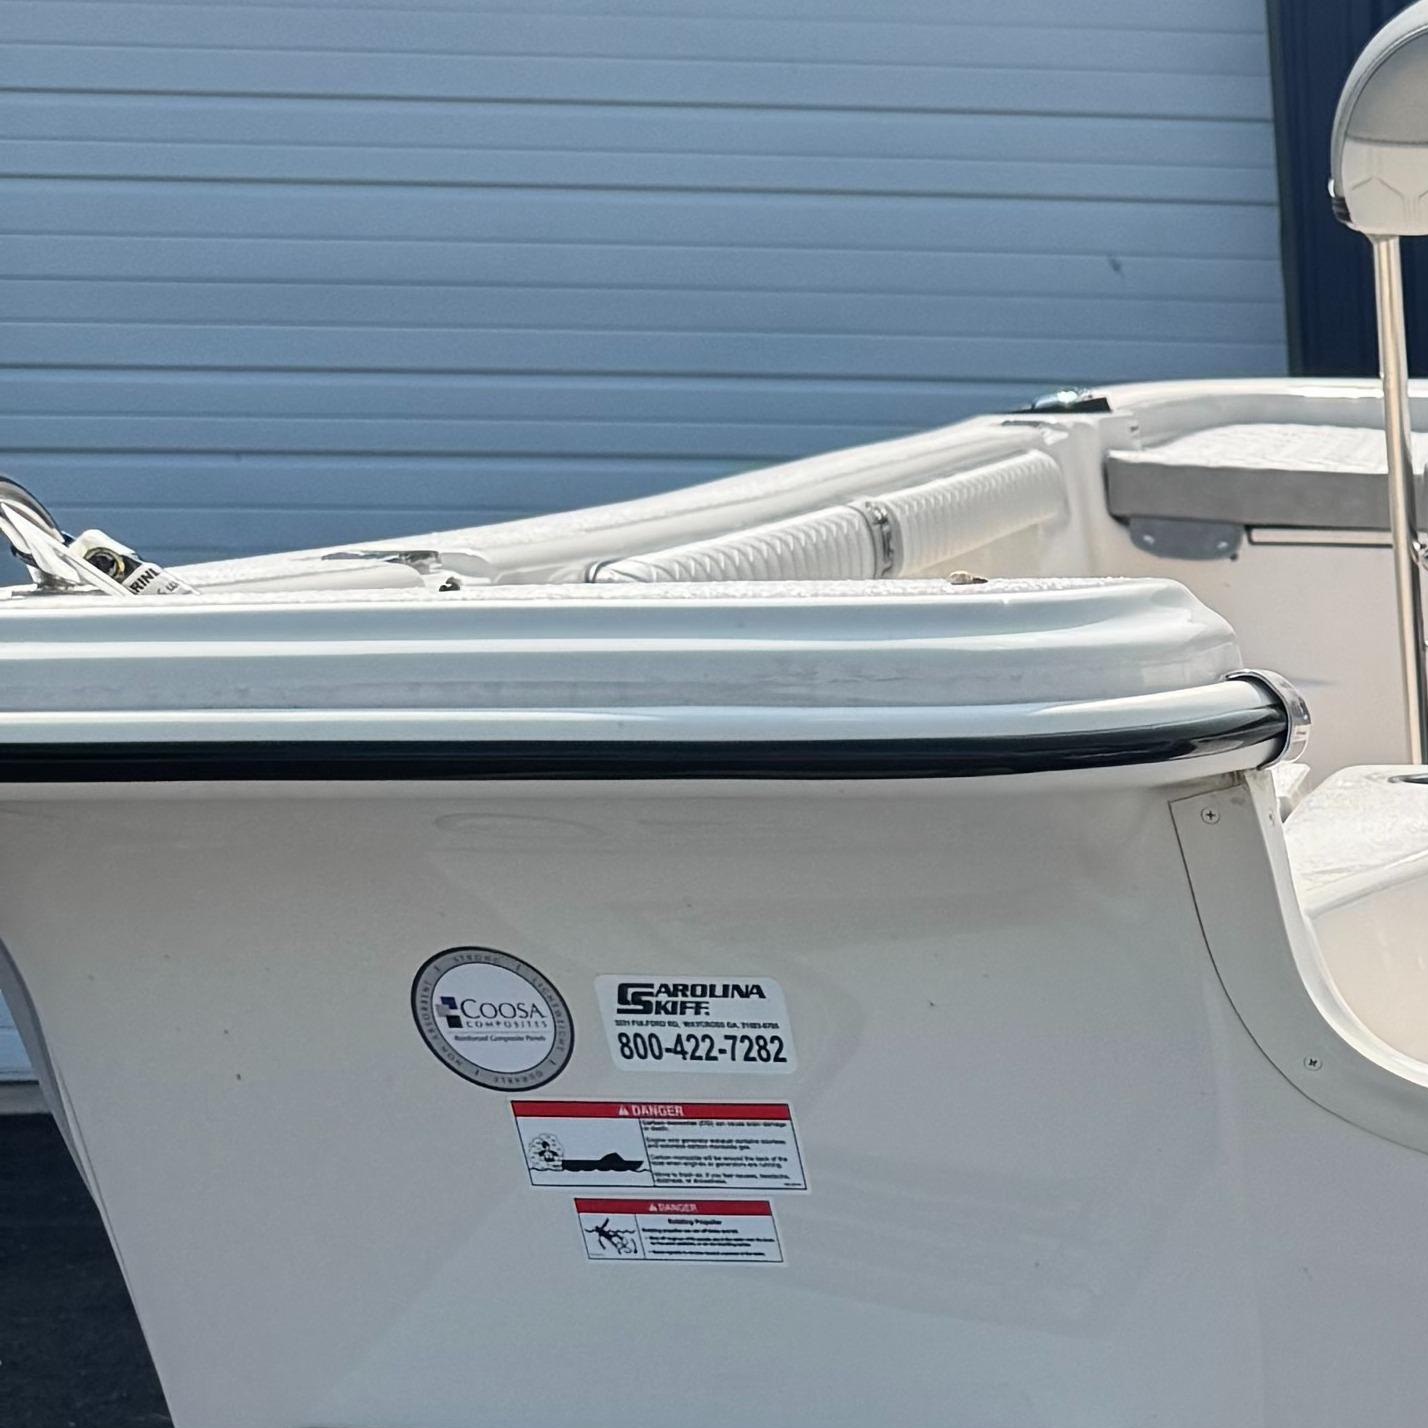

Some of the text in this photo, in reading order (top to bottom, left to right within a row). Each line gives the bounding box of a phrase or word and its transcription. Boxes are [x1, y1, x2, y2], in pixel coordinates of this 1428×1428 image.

[460, 999, 548, 1020] COOSA
[466, 1020, 548, 1029] COMPOSITES
[618, 1032, 788, 1063] 800-422-7282
[631, 1104, 684, 1117] DANGER
[657, 1203, 698, 1213] DANGER
